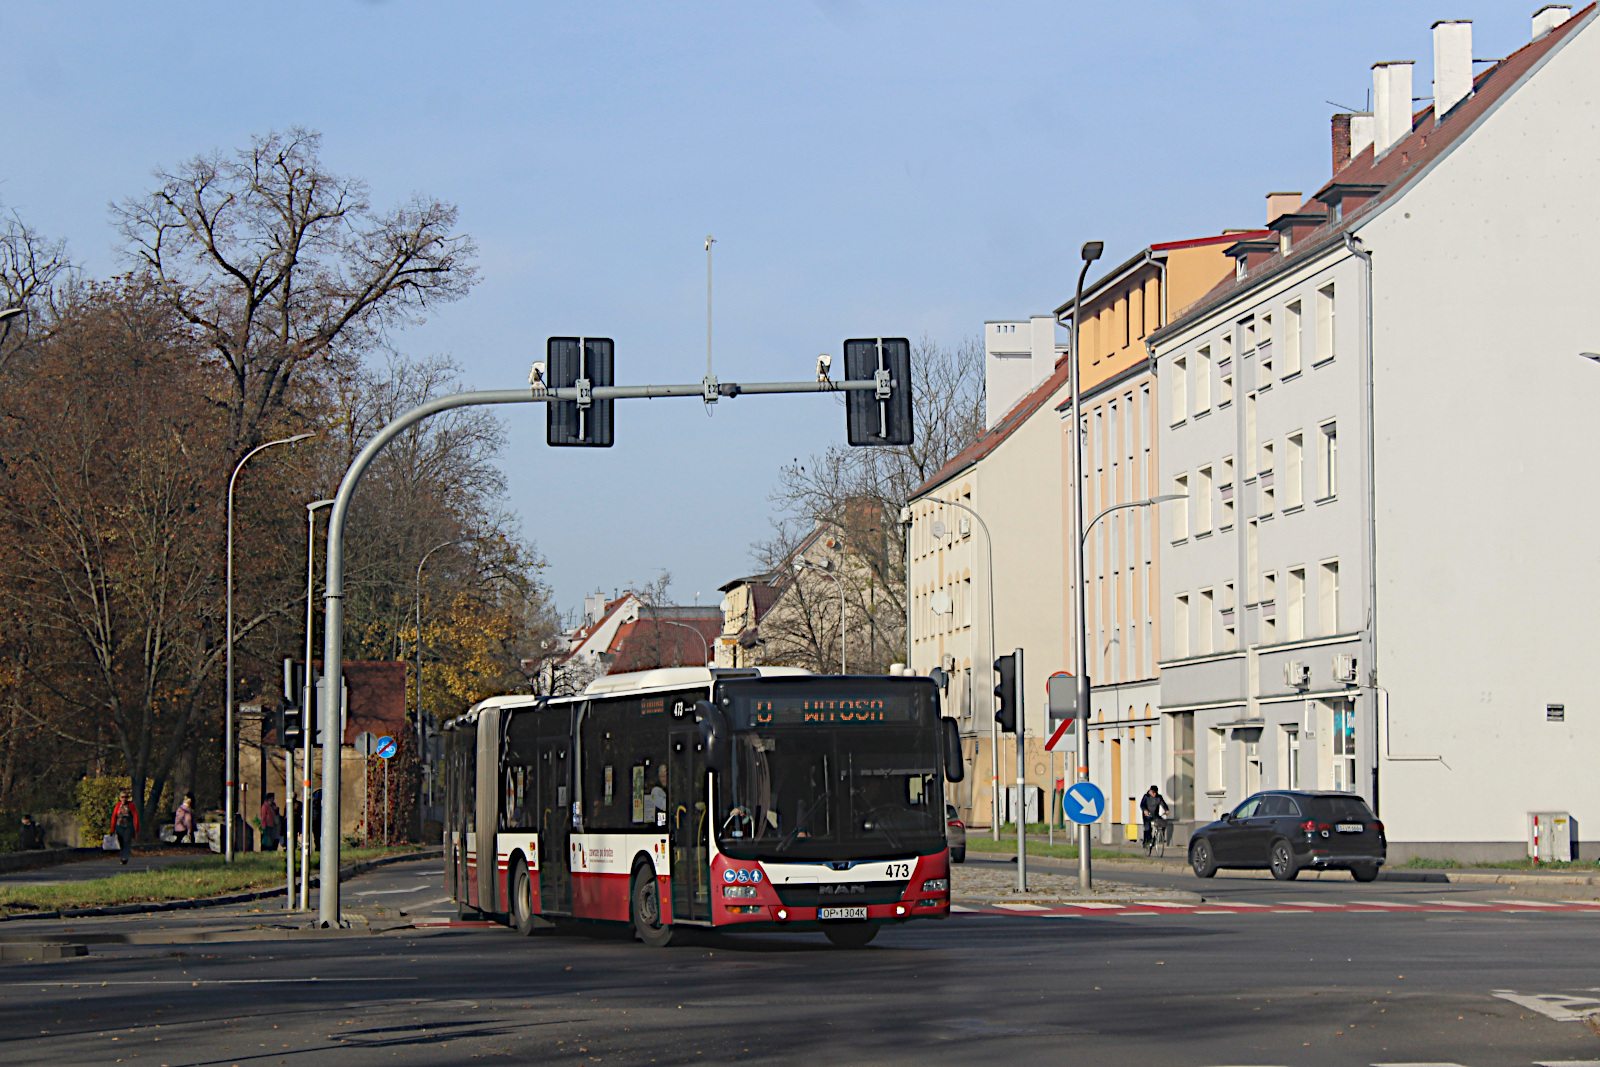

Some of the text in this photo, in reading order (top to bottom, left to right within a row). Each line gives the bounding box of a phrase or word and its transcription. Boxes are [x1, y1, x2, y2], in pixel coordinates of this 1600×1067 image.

[674, 701, 684, 717] 473
[885, 863, 909, 878] 473
[819, 884, 865, 895] MAN
